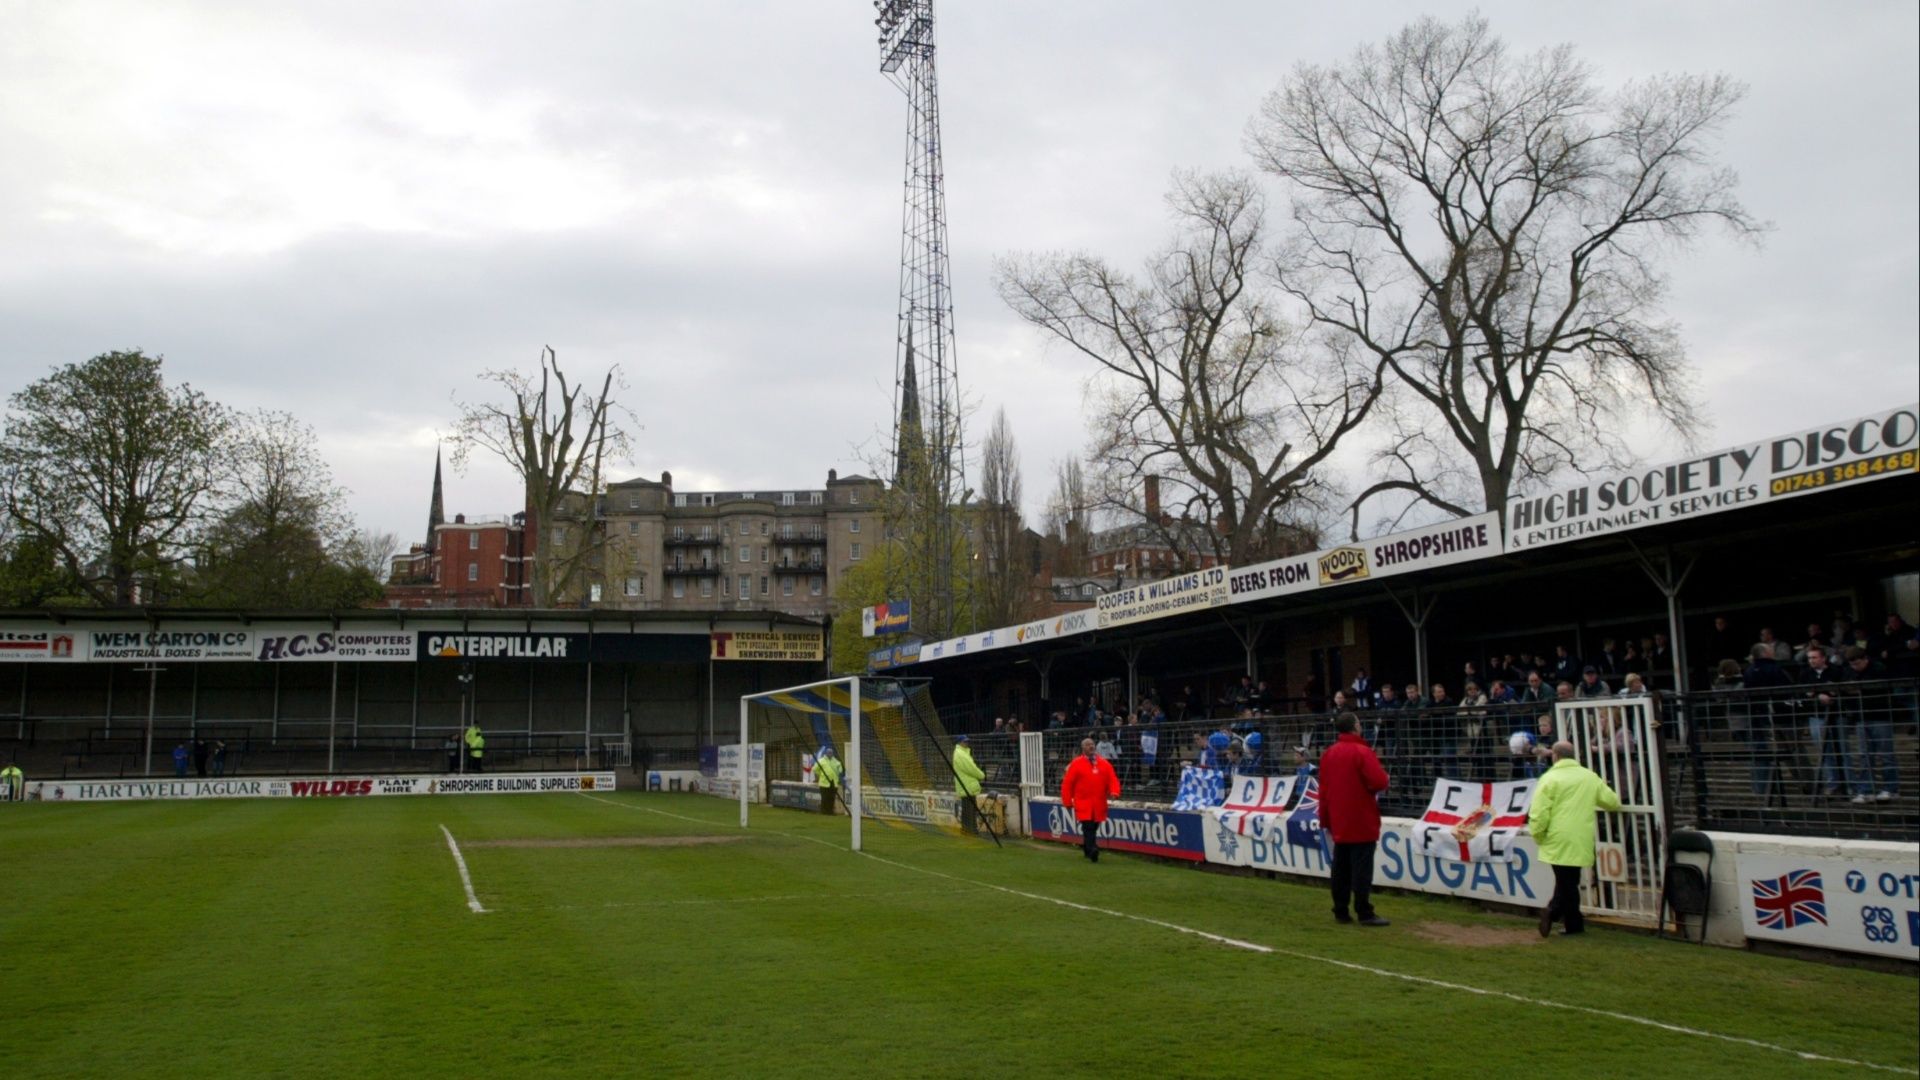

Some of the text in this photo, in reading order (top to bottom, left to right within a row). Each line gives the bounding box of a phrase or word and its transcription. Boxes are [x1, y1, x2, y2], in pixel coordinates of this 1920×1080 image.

[1513, 410, 1918, 530] HIGH SOCIETY DISCO
[1771, 452, 1914, 494] 01743 368468
[1511, 484, 1758, 548] & ENTERTAINMENT SERVICES
[1269, 562, 1310, 587] FROM
[1320, 551, 1364, 575] WOOD'S
[1375, 524, 1488, 567] SHROPSHIRE
[1099, 568, 1223, 610] COOPER & WILLIAMS LTD
[1025, 623, 1045, 640] ONYX
[1063, 614, 1087, 632] ONYX
[94, 632, 140, 646] WEM
[146, 632, 220, 646] CARTON
[338, 635, 412, 645] COMPUTERS
[735, 632, 820, 641] TECHNICAL SERVICES
[93, 649, 161, 658] INDUSTRIAL
[164, 649, 202, 658] BOXES
[338, 647, 366, 656] 01743
[428, 636, 567, 657] CATERPILLAR
[80, 781, 261, 798] HARTWELL JAGUAR
[290, 780, 374, 797] WILDES
[439, 779, 494, 792] SHROPSHIRE
[497, 778, 537, 791] BUILDING
[540, 777, 580, 790] SUPPLIES
[1243, 780, 1285, 804] C C
[1423, 826, 1441, 850] F
[1381, 831, 1536, 899] SUGAR
[1598, 847, 1623, 878] 10
